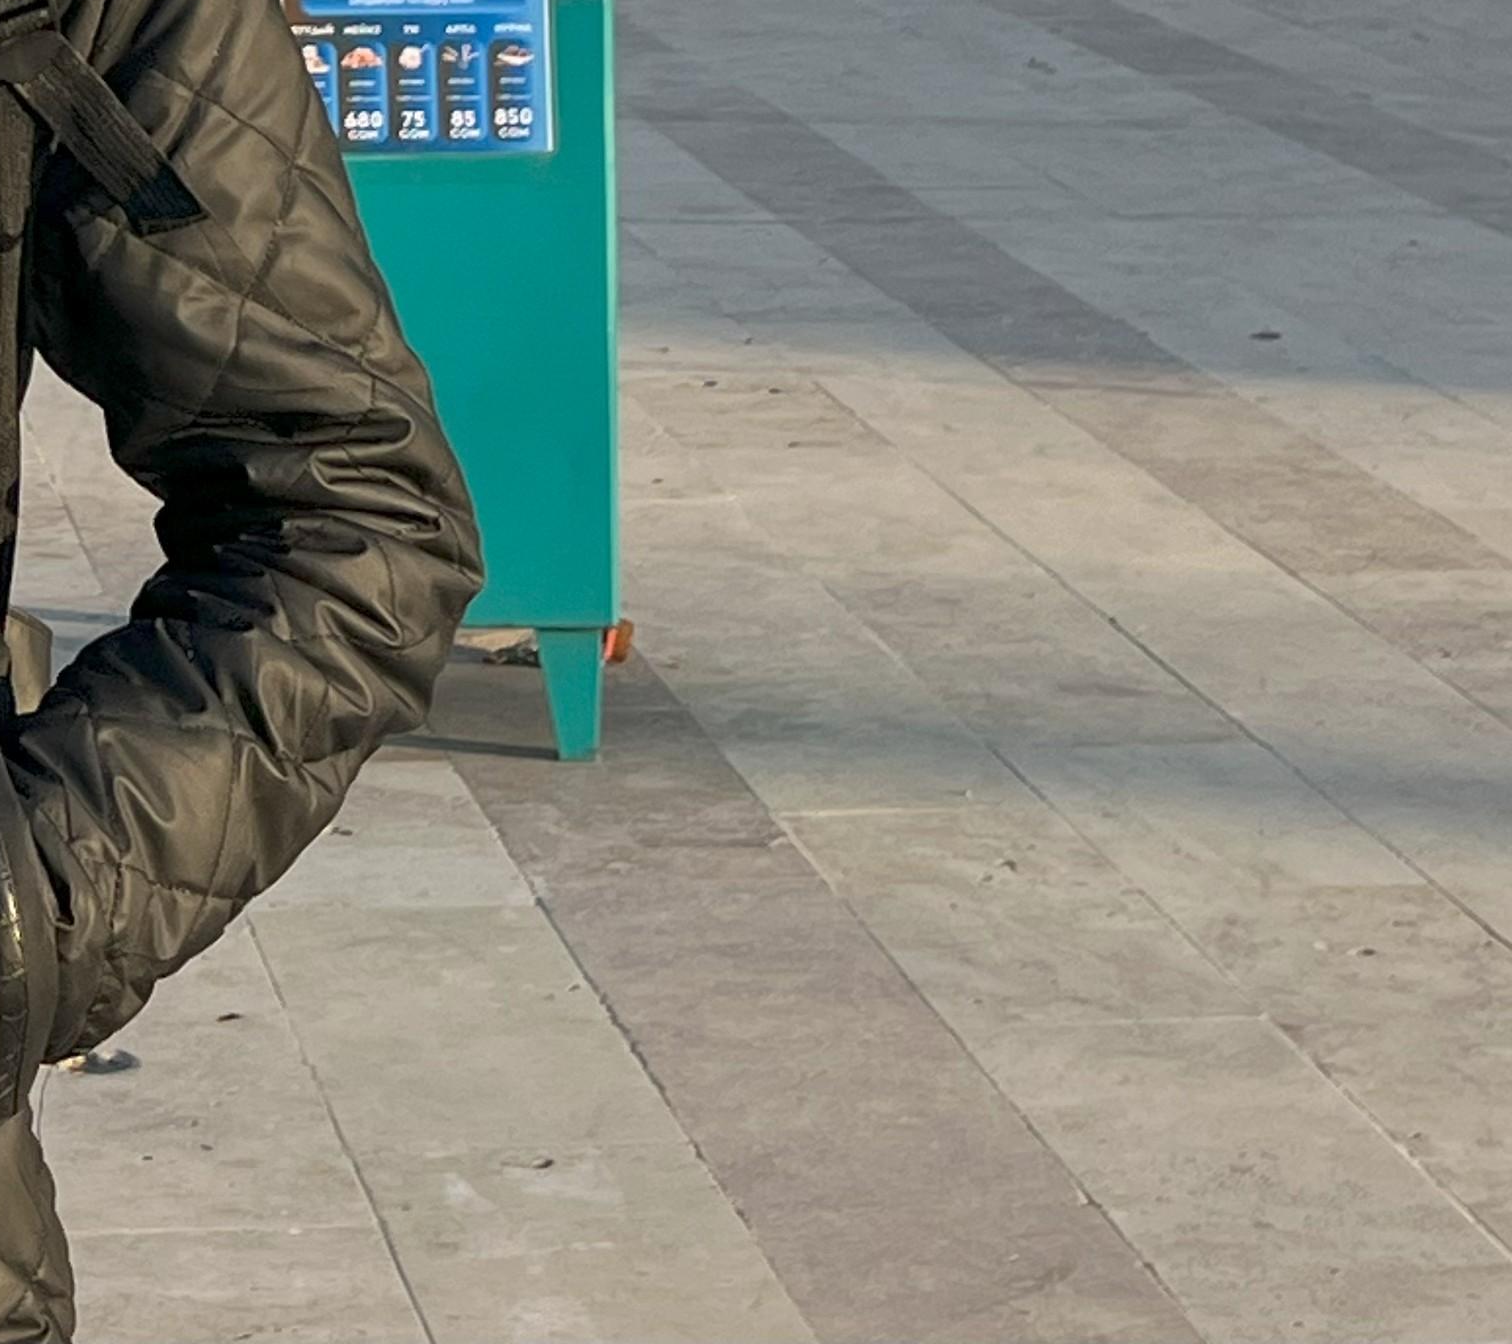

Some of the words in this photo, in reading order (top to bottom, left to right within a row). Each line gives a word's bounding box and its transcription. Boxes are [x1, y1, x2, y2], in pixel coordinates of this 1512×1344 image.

[400, 110, 426, 128] 75
[450, 110, 476, 128] 85
[493, 107, 533, 125] 850
